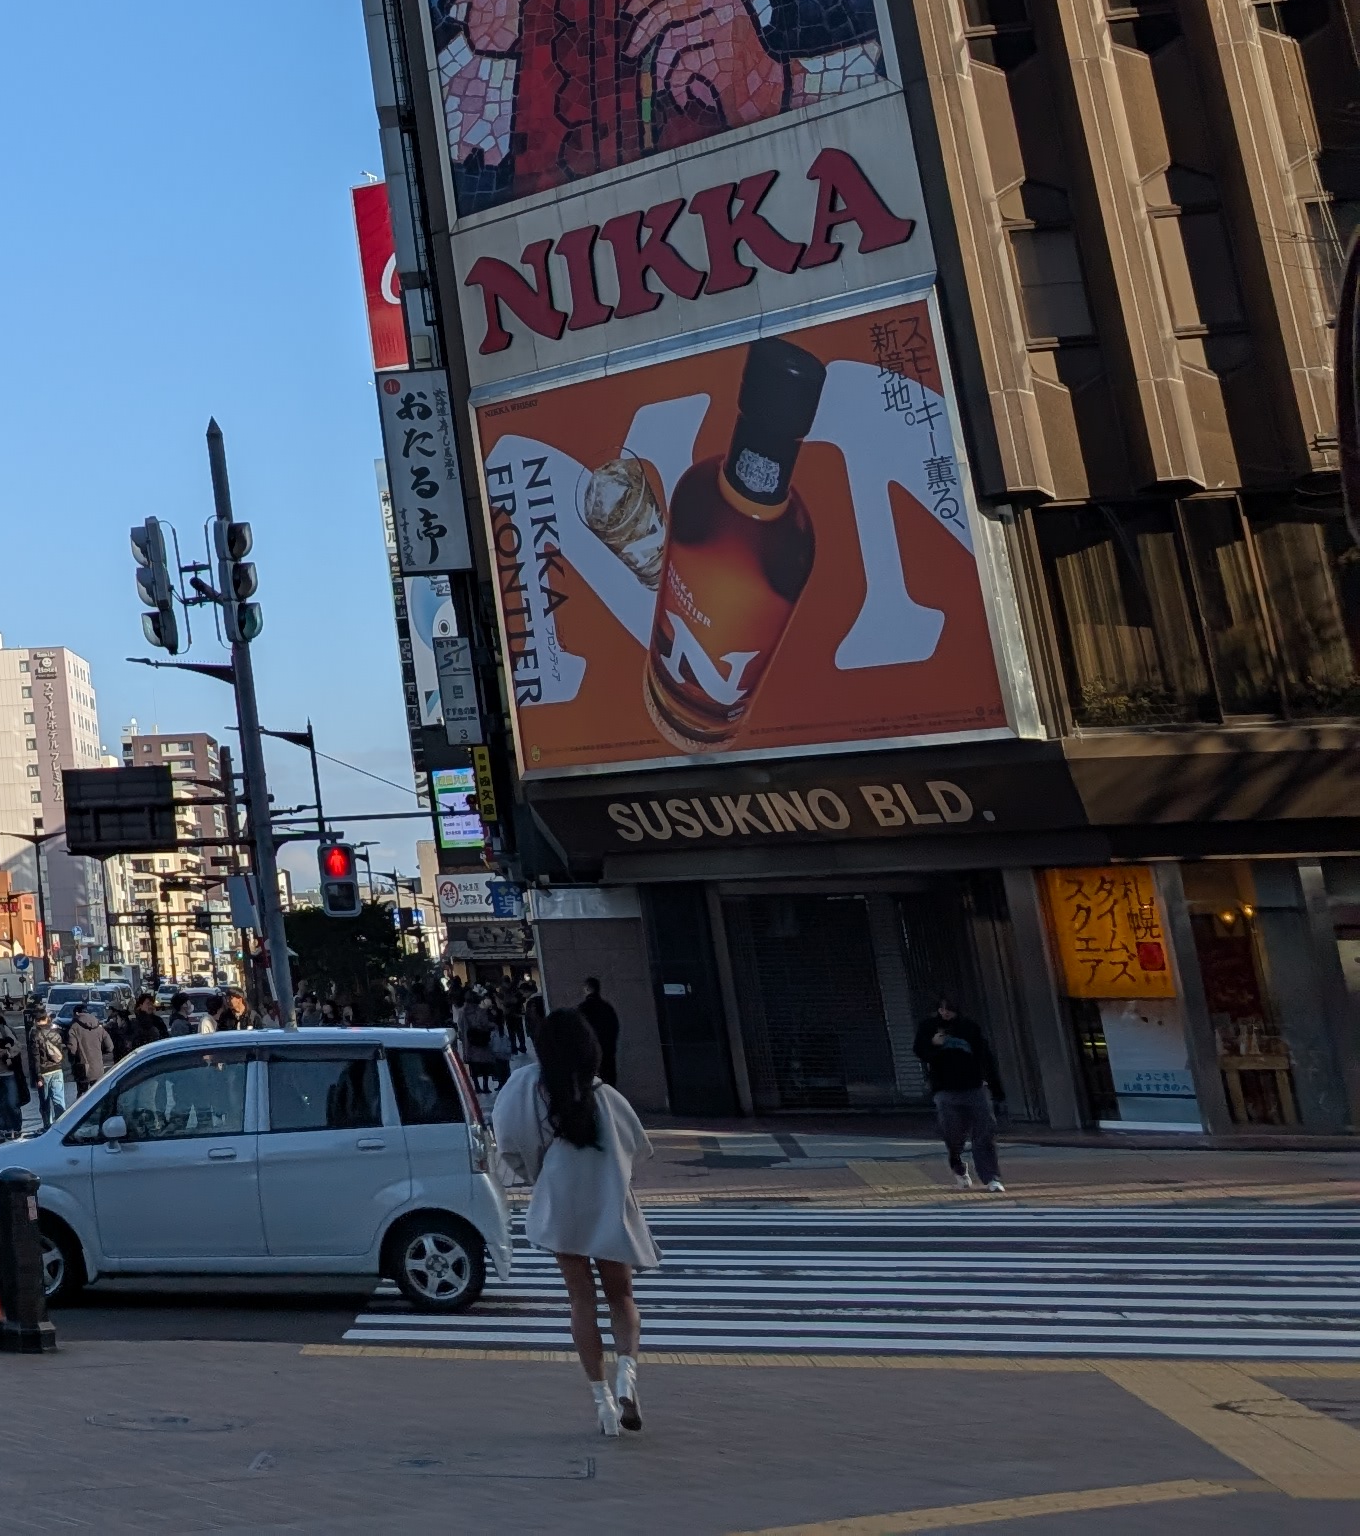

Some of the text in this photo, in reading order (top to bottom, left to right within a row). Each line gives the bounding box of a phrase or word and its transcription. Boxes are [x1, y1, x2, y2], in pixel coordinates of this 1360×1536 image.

[465, 147, 917, 356] NIKKA
[868, 318, 917, 426] 新境地。
[484, 406, 510, 418] NIKKA
[898, 316, 966, 530] スモーキー薫る、
[523, 454, 570, 620] NIKKA
[485, 464, 542, 708] FRONTIER
[667, 559, 694, 603] NIKKA
[667, 569, 712, 628] FRONTIER
[37, 666, 58, 675] Hotel
[545, 625, 562, 682] フロンティア
[460, 729, 469, 740] 3
[607, 779, 997, 842] SUSUKINO BLD.
[1064, 877, 1103, 986] スクエア
[1093, 874, 1137, 985] タイムズ
[1120, 875, 1163, 940] 札幌
[1133, 1070, 1177, 1083] ようこそ!
